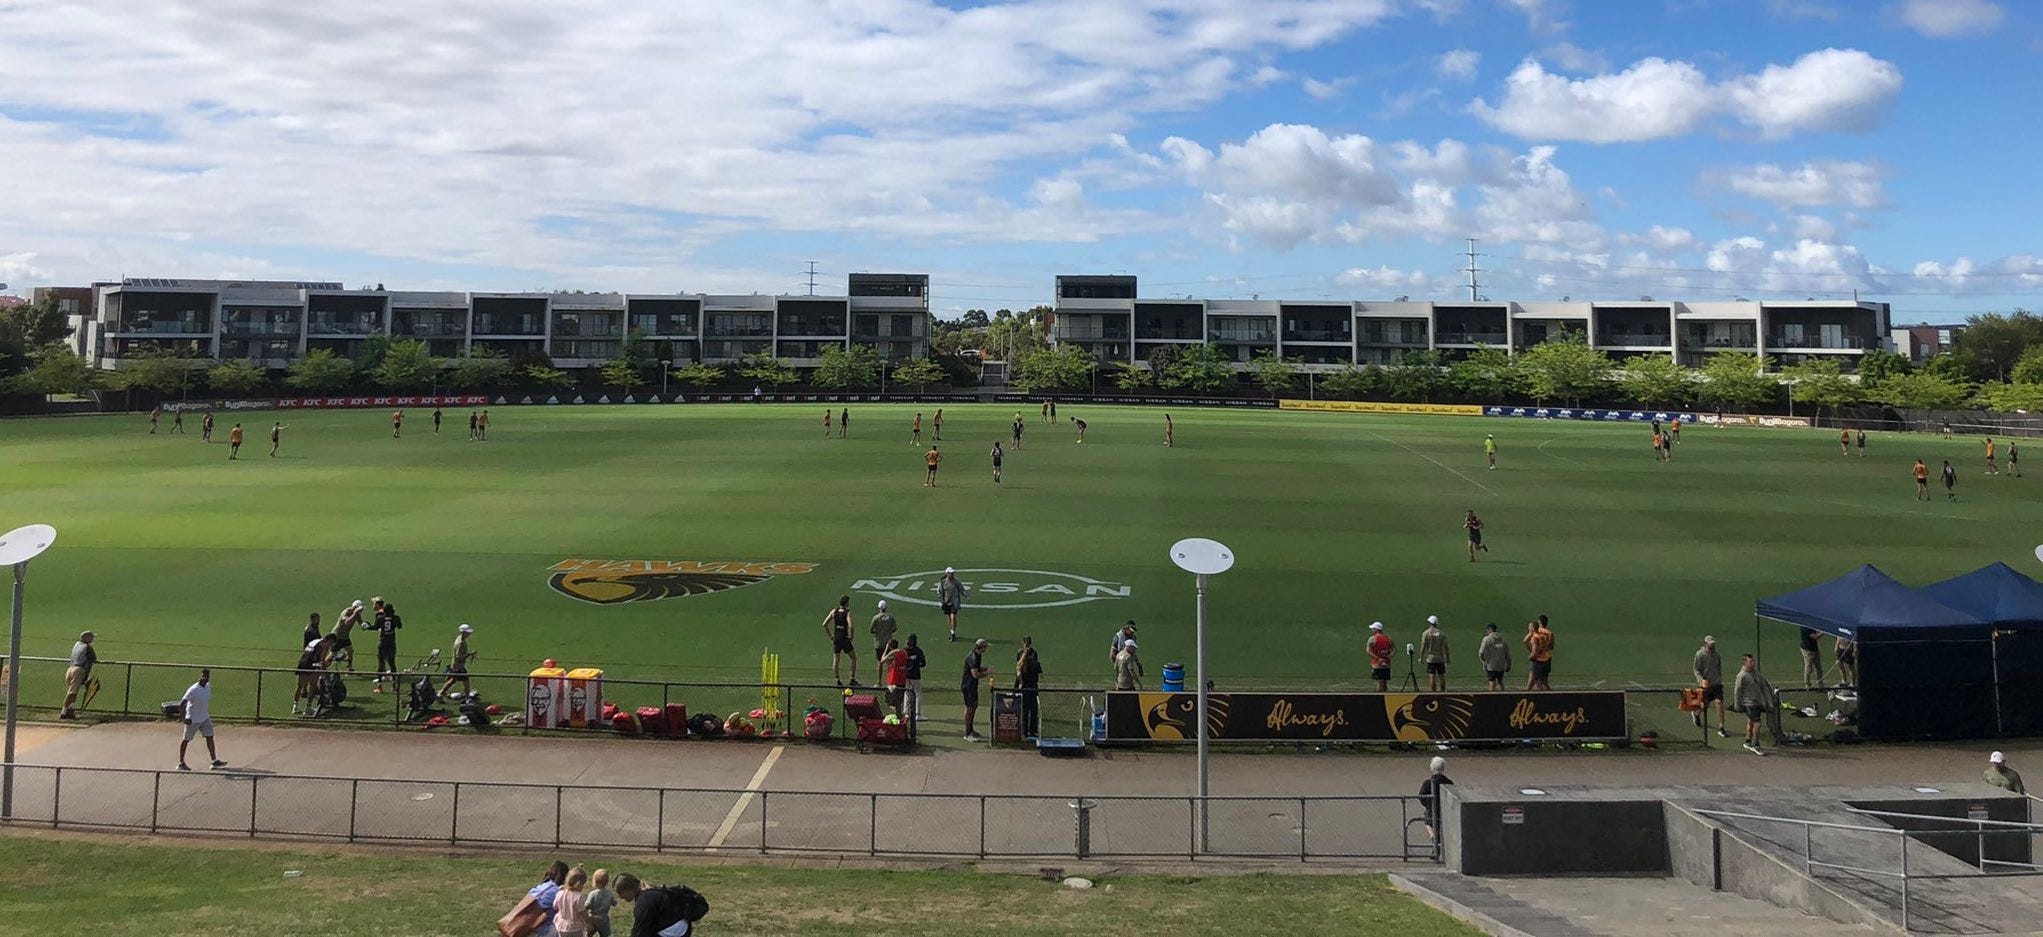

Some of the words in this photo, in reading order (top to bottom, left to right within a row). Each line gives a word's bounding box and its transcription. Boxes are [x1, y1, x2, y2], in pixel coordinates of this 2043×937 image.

[546, 559, 821, 575] HAWKS
[384, 621, 392, 631] 9
[1267, 699, 1349, 736] Always.
[1509, 698, 1589, 734] Always.
